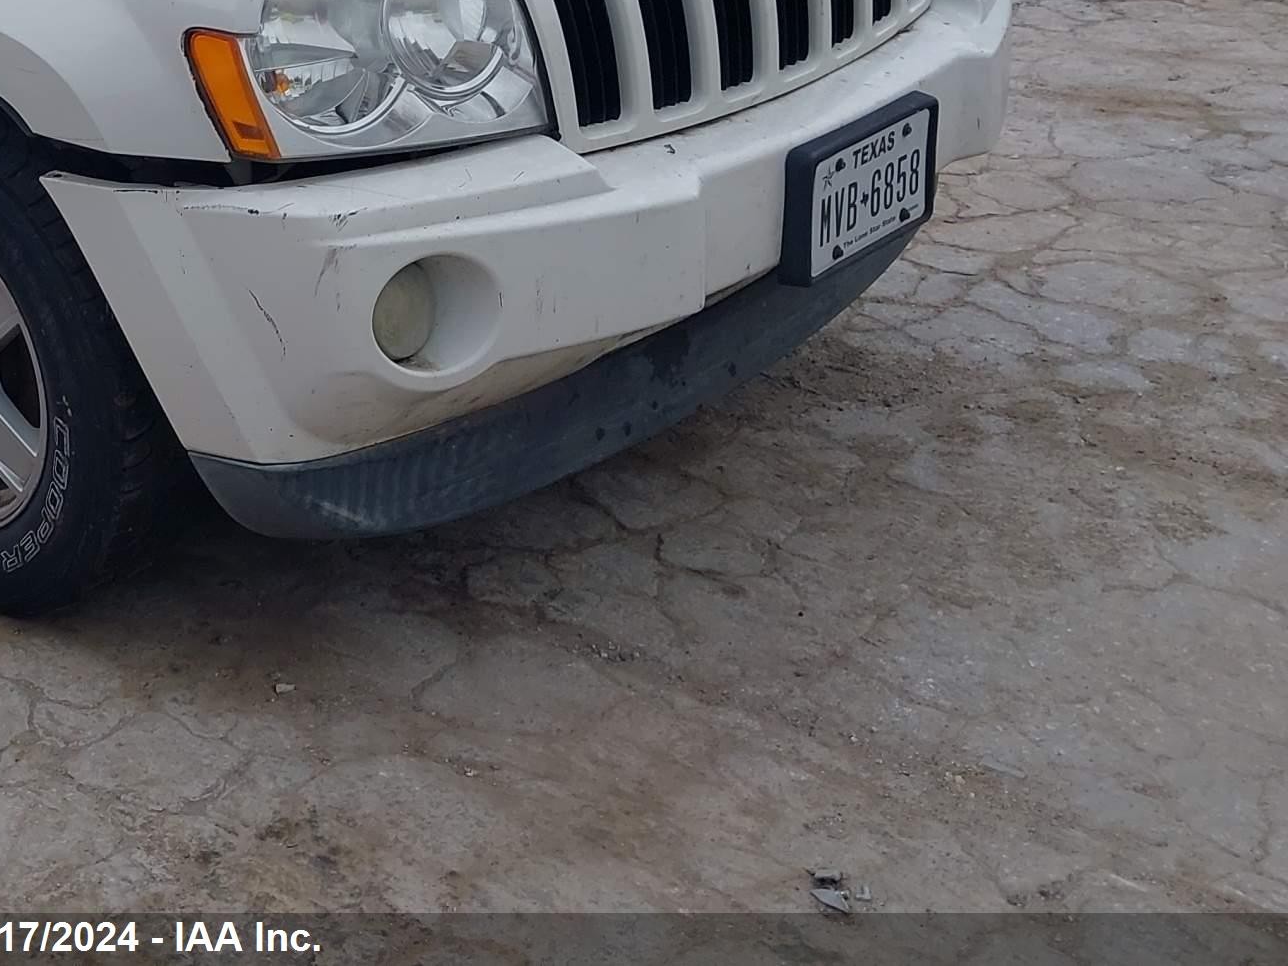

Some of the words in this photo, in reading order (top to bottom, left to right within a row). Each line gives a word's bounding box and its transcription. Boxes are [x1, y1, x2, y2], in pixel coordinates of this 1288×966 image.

[819, 181, 859, 248] MVB
[870, 148, 920, 217] 6858
[852, 131, 896, 169] TEXAS
[0, 416, 71, 573] COOPER
